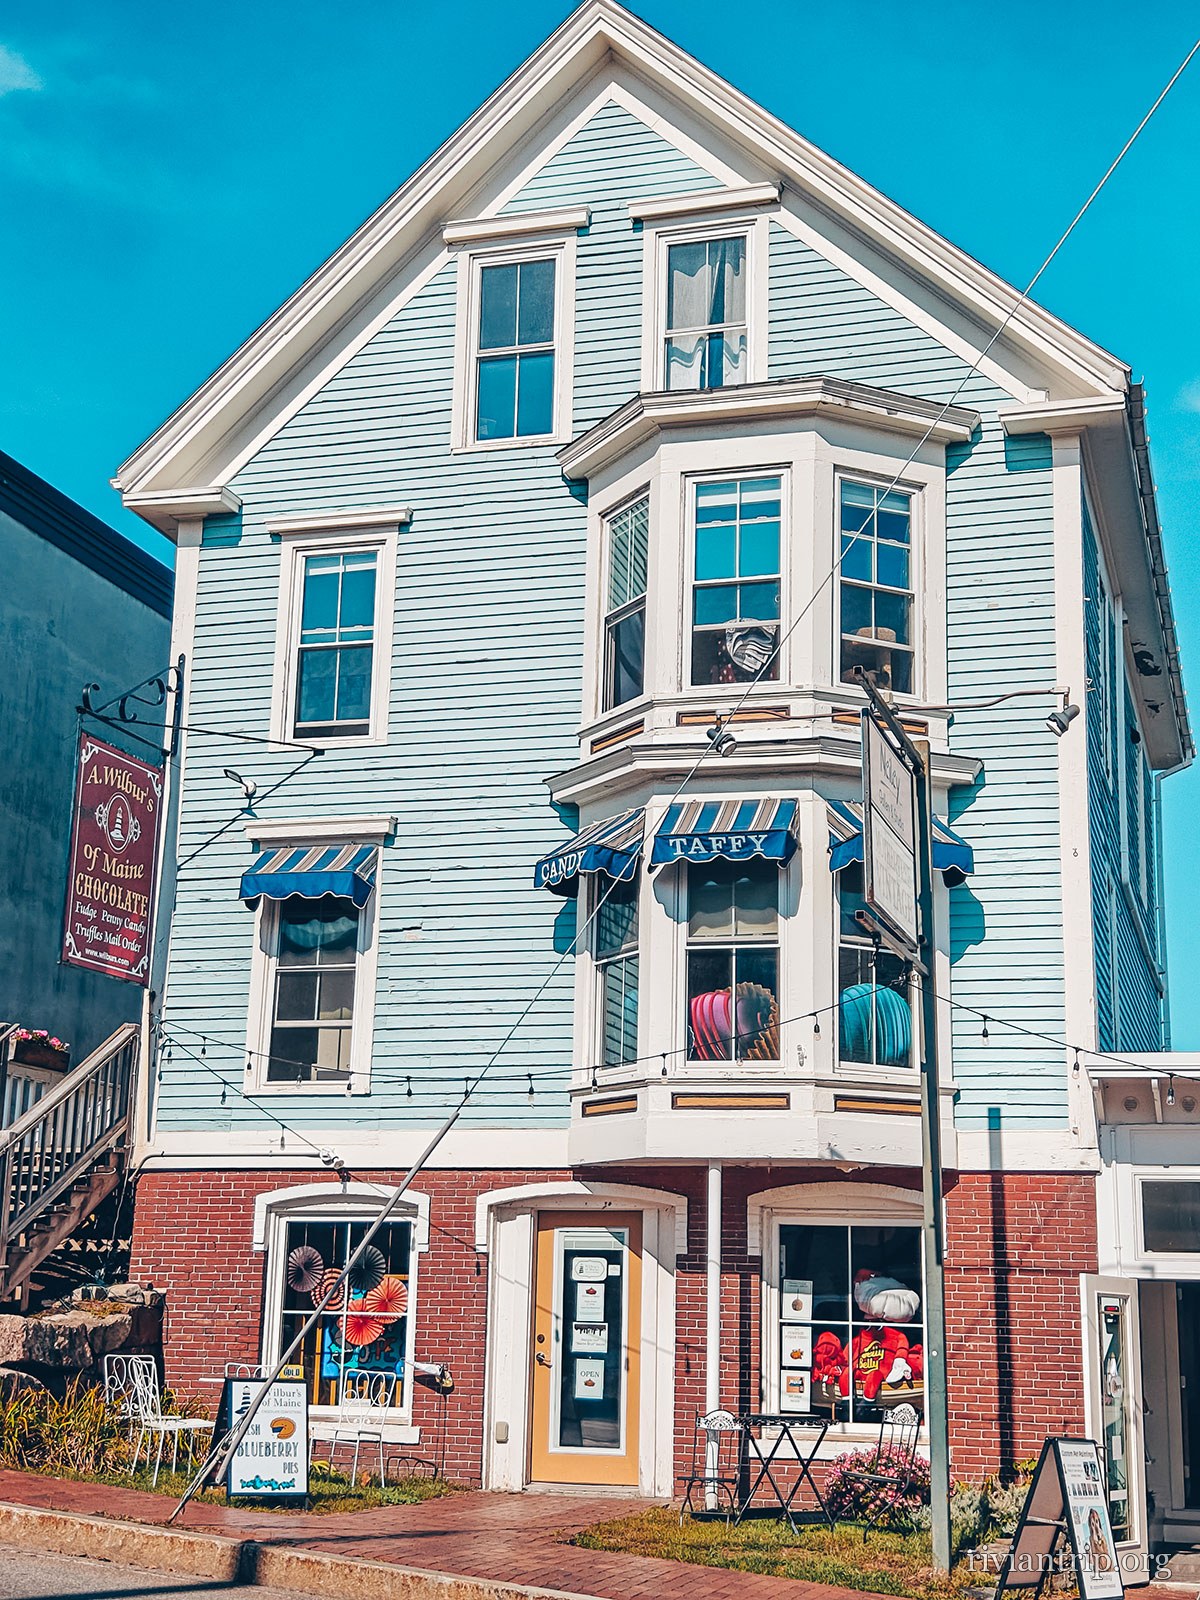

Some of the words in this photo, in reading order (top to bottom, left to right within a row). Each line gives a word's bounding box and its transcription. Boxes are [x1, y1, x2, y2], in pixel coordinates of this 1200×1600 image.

[668, 834, 768, 856] TAFFY
[102, 852, 145, 880] Maine
[541, 849, 587, 881] CANDY
[75, 872, 149, 918] CHOCOLATE
[75, 900, 98, 922] Fudge
[101, 909, 123, 931] Penny
[124, 917, 147, 939] Candy
[75, 922, 103, 943] Truffles
[103, 930, 122, 947] Mail
[121, 937, 142, 953] Order
[580, 1370, 600, 1378] OPEN
[858, 1357, 879, 1375] Belly
[261, 1398, 271, 1408] of
[273, 1398, 302, 1408] Maine
[268, 1388, 302, 1398] ilbur's
[236, 1441, 299, 1458] BLUEBERRY
[282, 1461, 299, 1474] PIES
